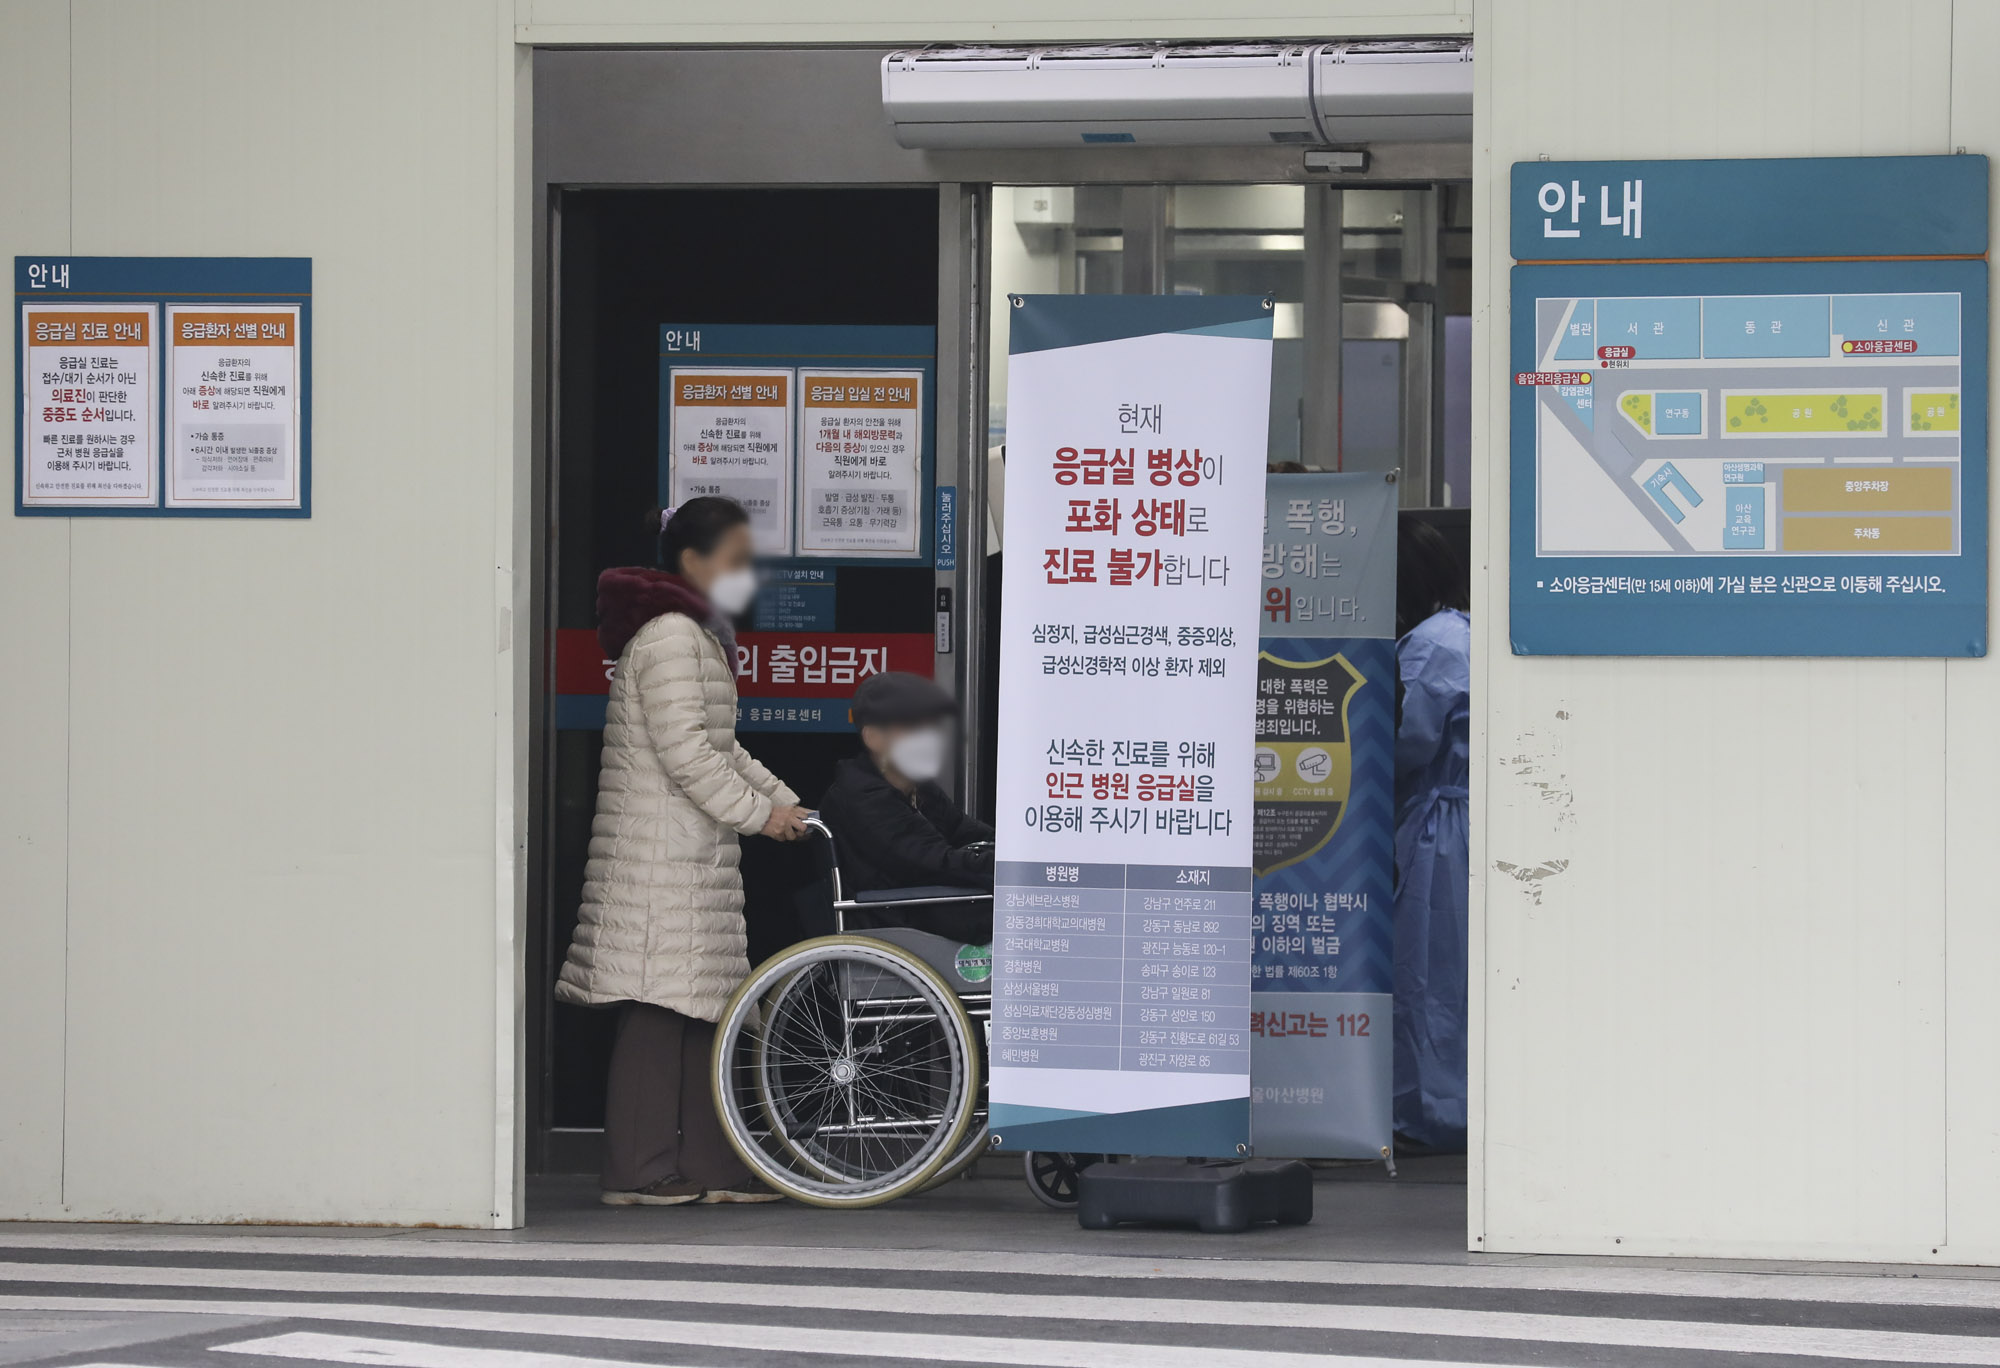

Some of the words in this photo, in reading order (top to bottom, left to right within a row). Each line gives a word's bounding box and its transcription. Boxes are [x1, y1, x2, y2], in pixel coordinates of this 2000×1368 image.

[1538, 180, 1643, 238] 안내
[28, 264, 69, 288] 안내
[35, 322, 76, 341] 응급실
[81, 323, 109, 340] 진료
[113, 323, 141, 340] 안내
[181, 322, 230, 339] 응급환자
[234, 322, 258, 339] 선별
[261, 322, 285, 339] 안내
[1570, 322, 1592, 336] 별관
[665, 331, 700, 351] 안내
[1854, 341, 1913, 353] 소아응급센터
[1604, 347, 1629, 358] 응급실
[59, 357, 87, 369] 응급실
[91, 357, 118, 369] 진료는
[1608, 360, 1630, 369] 현위치
[42, 373, 83, 385] 접수/대기
[86, 373, 114, 384] 순서가
[118, 373, 136, 385] 아닌
[1517, 373, 1580, 385] 음압격리응급실
[51, 389, 95, 403] 의료진이
[98, 391, 127, 403] 판단한
[682, 384, 727, 400] 응급환자
[730, 385, 752, 400] 선별
[755, 385, 778, 400] 안내
[811, 386, 845, 401] 응급실
[848, 387, 871, 401] 입실
[874, 387, 885, 401] 전
[888, 387, 911, 402] 안내
[1561, 386, 1593, 397] 감염관리
[1576, 399, 1593, 409] 센터
[43, 407, 77, 422] 중증도
[81, 407, 136, 422] 순서입니다.
[1118, 403, 1162, 434] 현재
[1665, 408, 1690, 419] 연구동
[43, 435, 58, 445] 빠른
[61, 435, 84, 445] 진료를
[86, 435, 117, 445] 원하시는
[120, 435, 136, 445] 경우
[57, 448, 72, 458] 근처
[75, 448, 90, 458] 병원
[93, 448, 124, 458] 응급실을
[47, 461, 70, 471] 이용해
[72, 461, 95, 471] 주시기
[98, 461, 131, 471] 바랍니다.
[1053, 447, 1135, 485] 응급실
[1147, 448, 1222, 486] 병상이
[1723, 463, 1764, 472] 아산생명과학
[1650, 467, 1673, 488] 기숙사
[1723, 473, 1744, 483] 연구원
[1844, 481, 1889, 492] 중앙주차장
[1735, 503, 1753, 514] 아산
[940, 492, 952, 554] 눌러주십시오
[1065, 498, 1121, 536] 포화
[1131, 499, 1209, 537] 상태로
[1286, 499, 1357, 537] 폭행,
[1735, 514, 1752, 525] 교육
[1731, 526, 1756, 536] 연구관
[1853, 528, 1881, 540] 주차동
[937, 559, 955, 567] PUSH
[1043, 547, 1097, 584] 진료
[1107, 548, 1230, 586] 불가합니다
[1550, 576, 1646, 594] 소아응급센터(만
[1649, 579, 1671, 593] 15세
[1674, 576, 1713, 594] 이하)에
[1718, 576, 1746, 594] 가실
[1749, 576, 1777, 594] 분은
[1781, 575, 1837, 594] 신관으로
[1840, 575, 1883, 594] 이동해
[1886, 575, 1947, 594] 주십시오.
[1032, 624, 1078, 645] 심정지,
[1083, 625, 1172, 647] 급성심근경색,
[1177, 626, 1236, 647] 중증외상,
[768, 645, 888, 684] 출입금지
[1042, 655, 1127, 675] 급성신경학적
[1132, 656, 1160, 677] 이상
[1164, 657, 1193, 677] 환자
[1198, 657, 1226, 678] 제외
[1260, 679, 1286, 694] 대한
[1290, 679, 1328, 694] 폭력은
[1284, 698, 1335, 715] 위협하는
[750, 708, 822, 721] 응급의료센터
[1255, 719, 1321, 735] 범죄입니다.
[1047, 738, 1105, 766] 신속한
[1111, 740, 1170, 767] 진료를
[1177, 741, 1215, 769] 위해
[1046, 772, 1084, 799] 인근
[1092, 772, 1129, 800] 병원
[1136, 774, 1215, 802] 응급실을
[1025, 805, 1083, 833] 이용해
[1089, 807, 1148, 834] 주시기
[1155, 808, 1232, 836] 바랍니다
[1046, 866, 1079, 882] 병원병
[1176, 870, 1211, 885] 소재지
[1005, 893, 1080, 909] 강남세브란스병원
[1143, 897, 1171, 911] 강남구
[1174, 897, 1201, 911] 언주로
[1204, 899, 1216, 911] 211
[1259, 892, 1318, 912] 폭행이나
[1323, 892, 1368, 912] 협박시
[1005, 916, 1106, 931] 강동경희대학교의대병원
[1143, 919, 1171, 934] 강동구
[1173, 920, 1200, 934] 동남로
[1203, 921, 1220, 934] 892
[1271, 914, 1300, 933] 징역
[1306, 915, 1336, 933] 또는
[1004, 938, 1070, 953] 건국대학교병원
[1142, 941, 1170, 956] 광진구
[1173, 942, 1200, 956] 능동로
[1203, 944, 1226, 956] 120-1
[1262, 936, 1305, 955] 이하의
[1311, 936, 1341, 955] 벌금
[1004, 960, 1042, 974] 경찰병원
[1140, 964, 1169, 978] 송파구
[1172, 964, 1199, 978] 송이로
[1202, 966, 1217, 978] 123
[1265, 965, 1284, 978] 법률
[1288, 965, 1320, 978] 제60조
[1323, 965, 1338, 979] 1항
[1003, 983, 1059, 997] 삼성서울병원
[1140, 986, 1169, 1000] 강남구
[1171, 986, 1199, 1001] 일원로
[1201, 988, 1211, 1000] 81
[1002, 1004, 1112, 1021] 성심의료재단강동성심병원
[1140, 1008, 1168, 1023] 강동구
[1171, 1008, 1199, 1023] 성안로
[1200, 1010, 1216, 1023] 150
[1336, 1013, 1371, 1037] 112
[1001, 1026, 1058, 1041] 중앙보훈병원
[1138, 1031, 1167, 1046] 강동구
[1170, 1031, 1206, 1046] 진황도로
[1208, 1032, 1227, 1046] 61길
[1229, 1034, 1240, 1046] 53
[1001, 1048, 1039, 1063] 혜민병원
[1138, 1052, 1167, 1067] 광진구
[1169, 1053, 1196, 1068] 자양로
[1199, 1055, 1211, 1067] 85
